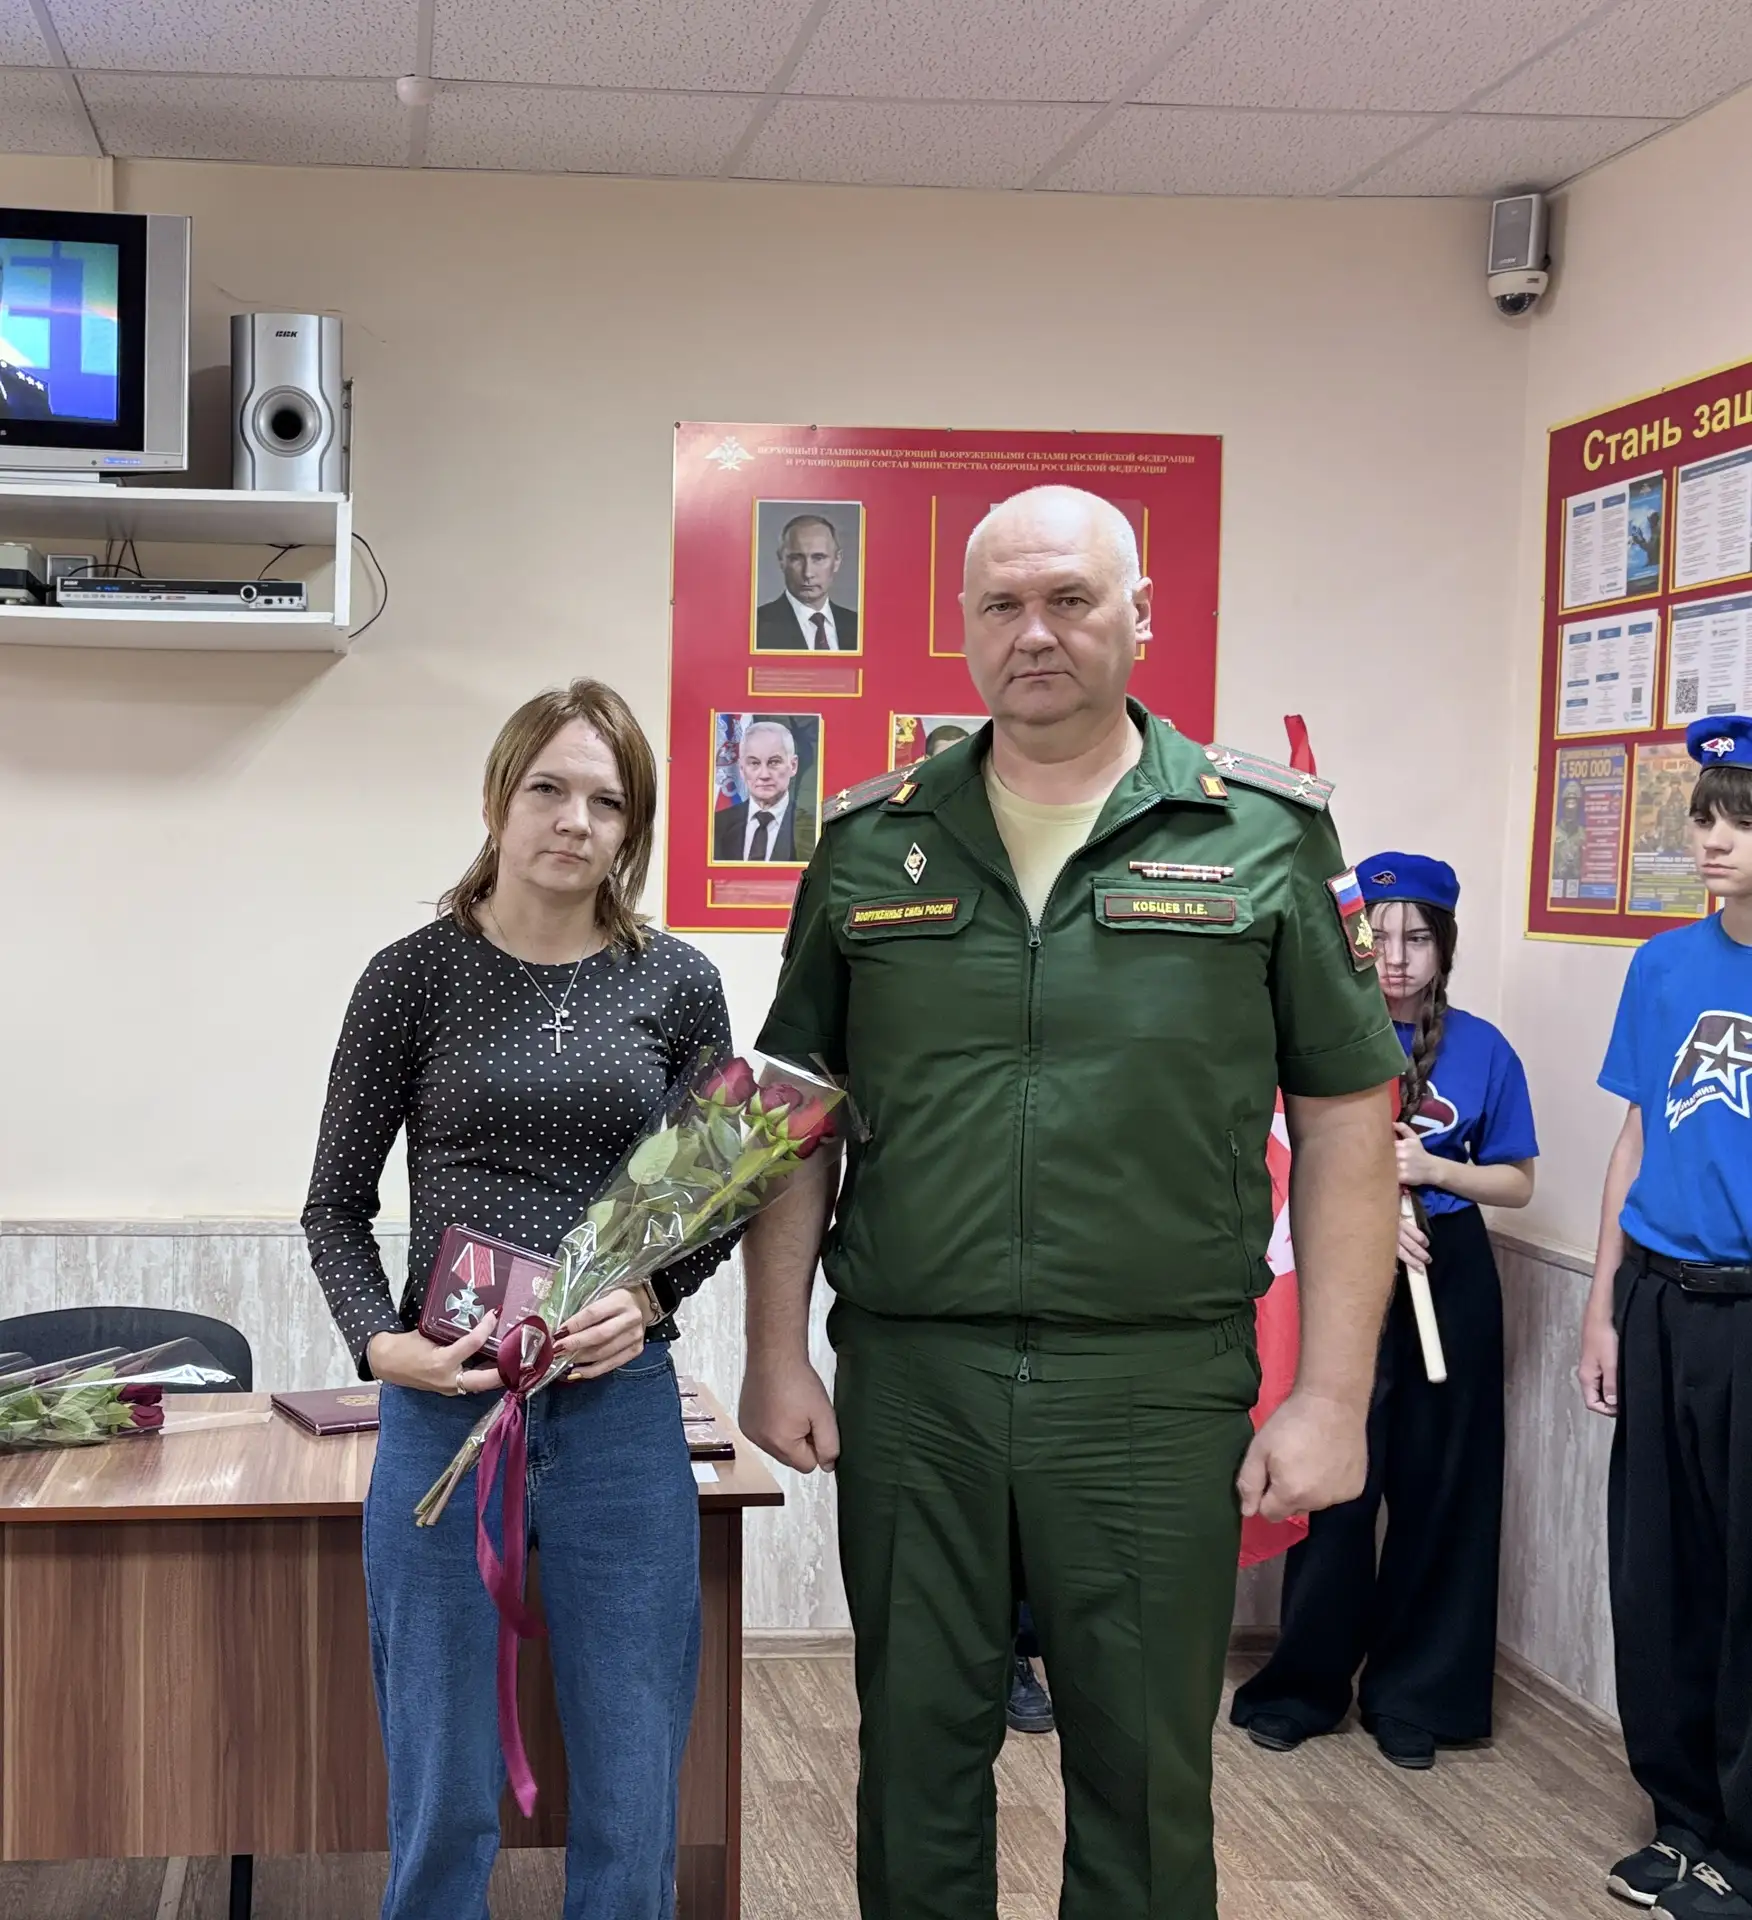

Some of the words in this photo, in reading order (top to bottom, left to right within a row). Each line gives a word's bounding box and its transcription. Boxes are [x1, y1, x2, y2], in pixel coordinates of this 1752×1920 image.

[1583, 416, 1682, 472] Стань
[819, 447, 937, 459] ГЛАВНОКОМАНДУЮЩИЙ
[939, 450, 1024, 460] ВООРУЖЕННЫМИ
[1026, 452, 1068, 461] СИЛАМИ
[1070, 452, 1135, 462] РОССИЙСКОЙ
[1137, 454, 1195, 464] ФЕДЕРАЦИИ
[785, 458, 793, 466] И
[794, 458, 869, 468] РУКОВОДЯЩИЙ
[871, 460, 909, 469] СОСТАВ
[911, 461, 988, 470] МИНИСТЕРСТВА
[990, 462, 1038, 471] ОБОРОНЫ
[1040, 462, 1106, 473] РОССИЙСКОЙ
[1108, 464, 1167, 474] ФЕДЕРАЦИИ
[854, 908, 904, 922] ВООРУЖЕННЫЕ
[904, 906, 924, 918] СИЛЫ
[924, 903, 954, 915] РОССИИ
[1133, 901, 1180, 914] КОБЦЕВ
[1184, 903, 1208, 915] П.Е.
